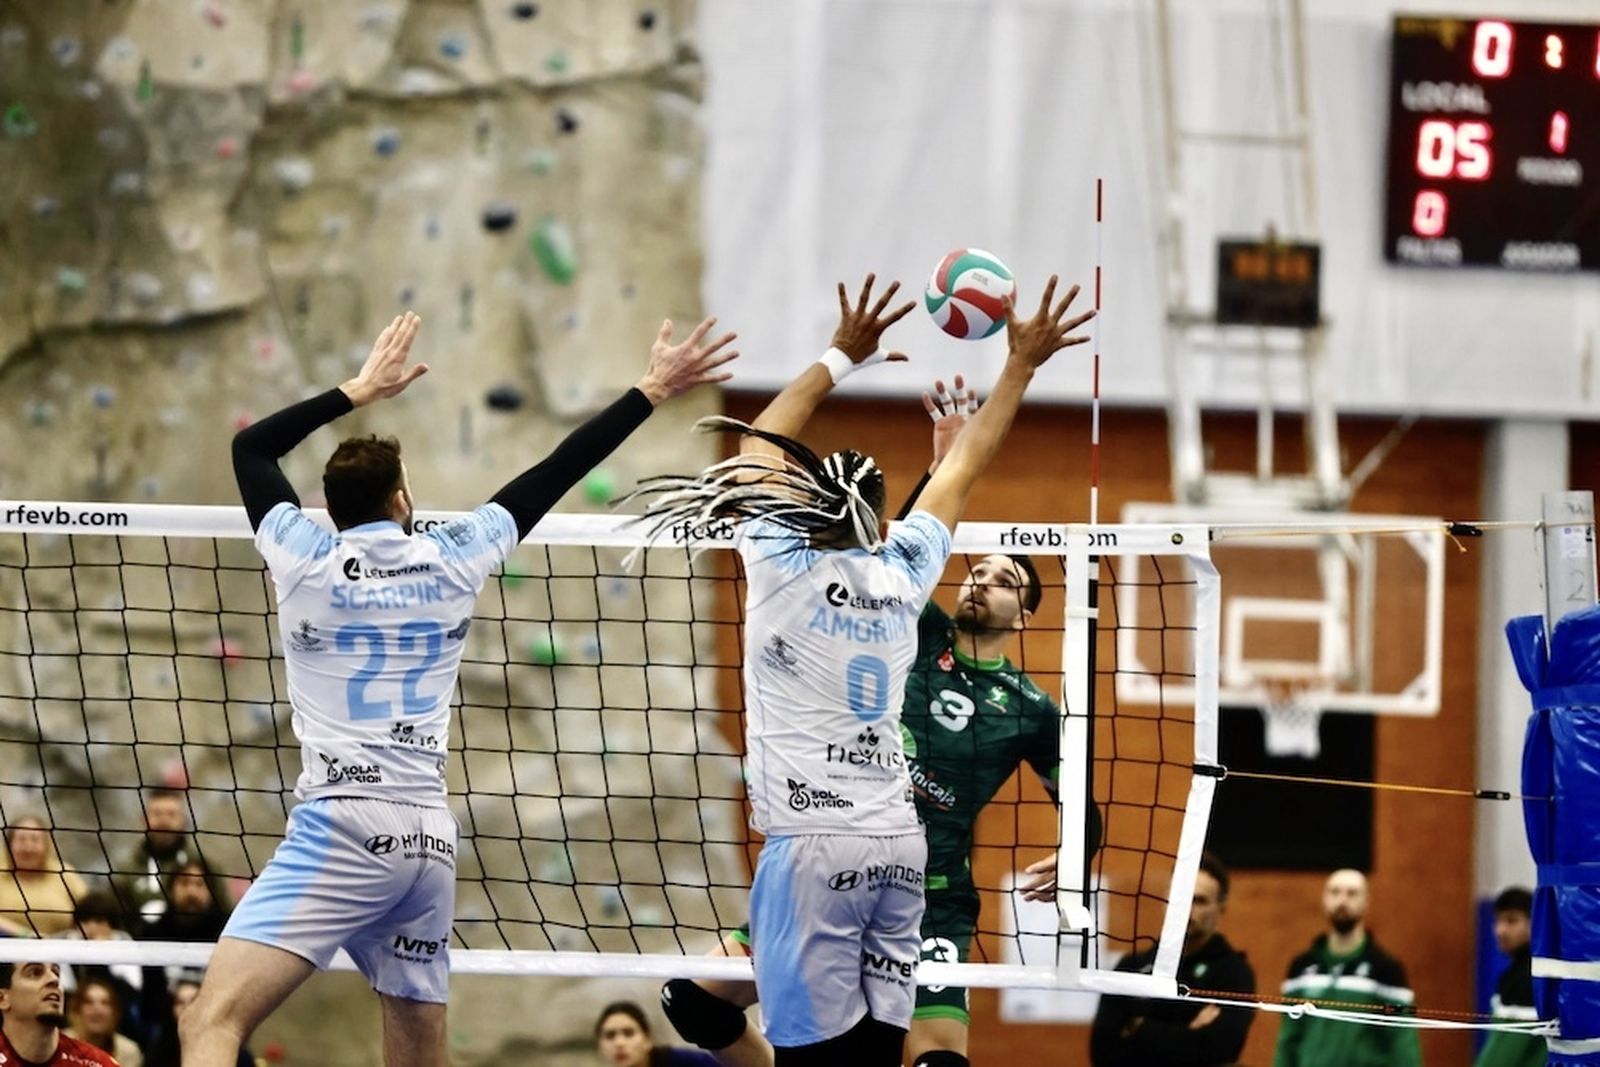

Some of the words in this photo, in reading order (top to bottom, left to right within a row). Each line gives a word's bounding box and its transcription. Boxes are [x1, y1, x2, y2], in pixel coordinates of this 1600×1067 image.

[1473, 18, 1513, 78] 0
[1417, 120, 1492, 179] 05
[1550, 110, 1567, 153] 1
[1413, 190, 1446, 237] 0
[6, 505, 128, 526] rfevb.com
[330, 575, 443, 610] SCARPIN
[335, 617, 442, 721] 22
[846, 654, 889, 722] 0
[930, 689, 975, 732] 3
